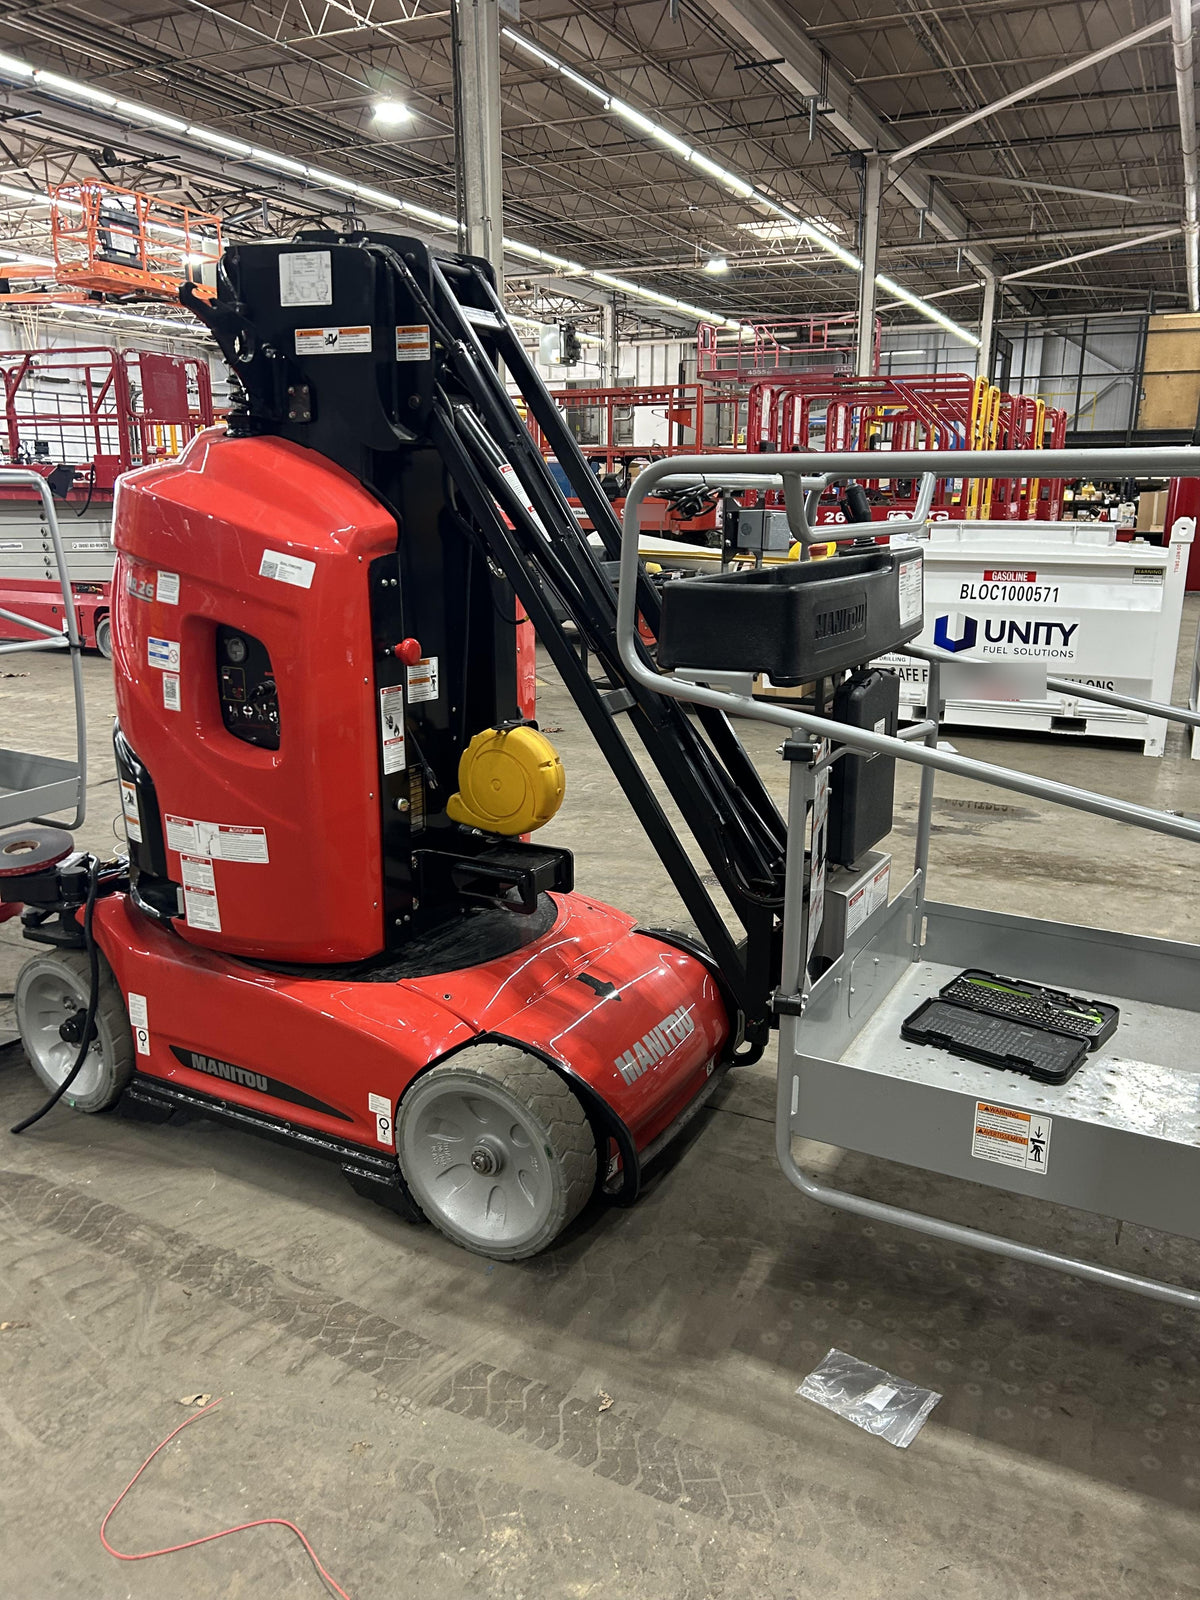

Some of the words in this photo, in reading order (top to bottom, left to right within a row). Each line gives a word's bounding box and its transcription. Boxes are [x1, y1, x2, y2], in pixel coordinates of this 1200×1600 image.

[992, 571, 1028, 581] GASOLINE
[960, 584, 1059, 603] BLOC1000571
[815, 604, 865, 640] MANITOU
[984, 619, 1079, 646] UNITY
[983, 646, 1008, 655] FUEL
[1013, 647, 1074, 658] SOLUTIONS
[899, 668, 919, 681] AFE
[614, 1005, 695, 1086] MANITOU
[191, 1053, 268, 1092] MANITOU
[989, 1106, 1019, 1118] WARNING
